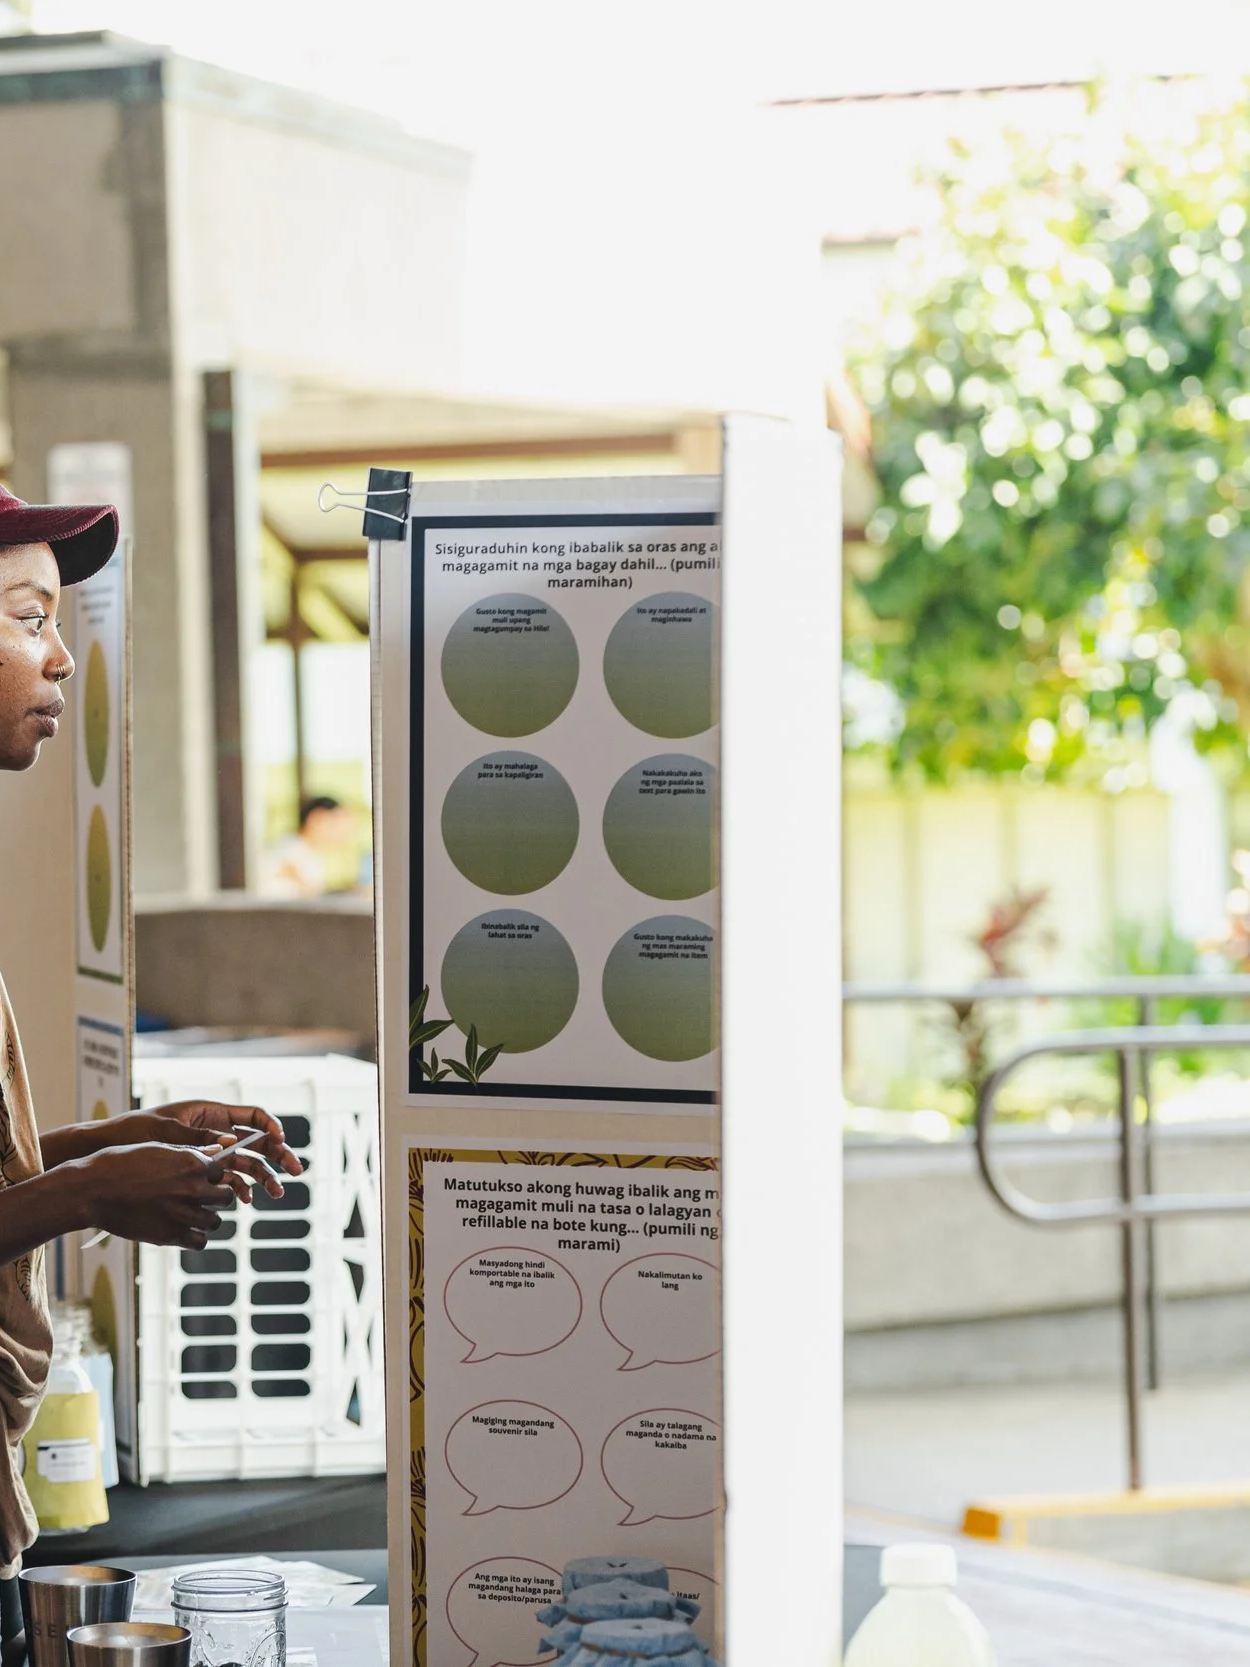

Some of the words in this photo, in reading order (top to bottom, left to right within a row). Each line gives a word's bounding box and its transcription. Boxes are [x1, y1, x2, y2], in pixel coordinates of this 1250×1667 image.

[436, 542, 528, 557] Sisiguraduhin
[532, 542, 565, 556] kong
[570, 541, 624, 553] ibabalik
[628, 543, 643, 552] sa
[647, 543, 676, 552] oras
[680, 543, 706, 555] ang
[442, 560, 518, 574] magagamit
[523, 562, 539, 571] na
[544, 562, 572, 573] mga
[576, 559, 617, 573] bagay
[621, 559, 666, 570] dahil...
[671, 558, 720, 573] (pumili
[548, 576, 633, 589] maramihan)
[498, 608, 515, 616] kong
[517, 608, 547, 616] magamit
[658, 607, 699, 615] napakadali
[651, 616, 692, 624] maginhawa
[504, 763, 538, 771] mahalaga
[478, 772, 494, 780] para
[505, 772, 543, 780] kapaligiran
[673, 788, 694, 796] gawin
[656, 934, 674, 942] kong
[642, 943, 651, 951] ng
[669, 943, 705, 951] maraming
[639, 951, 679, 959] magagamit
[444, 1178, 523, 1193] Matutukso
[526, 1181, 572, 1198] akong
[575, 1182, 624, 1200] huwag
[628, 1184, 670, 1198] ibalik
[674, 1188, 701, 1202] ang
[456, 1199, 537, 1213] magagamit
[541, 1200, 573, 1213] muli
[578, 1203, 596, 1213] na
[600, 1203, 631, 1215] tasa
[636, 1205, 645, 1215] o
[649, 1203, 711, 1220] lalagyan
[462, 1215, 527, 1229] refillable
[531, 1220, 548, 1230] na
[553, 1218, 586, 1232] bote
[591, 1219, 639, 1236] kung...
[643, 1222, 696, 1237] (pumili
[701, 1226, 719, 1240] ng
[558, 1239, 621, 1253] marami)
[479, 1260, 524, 1270] Masyadong
[525, 1261, 545, 1269] hindi
[470, 1269, 520, 1278] komportable
[533, 1271, 555, 1279] ibalik
[638, 1271, 690, 1280] Nakalimutan
[490, 1280, 504, 1288] ang
[506, 1281, 522, 1289] mga
[524, 1280, 535, 1288] ito
[662, 1281, 679, 1291] lang
[472, 1416, 507, 1426] Magiging
[509, 1419, 554, 1429] magandang
[640, 1420, 654, 1428] Sila
[668, 1422, 702, 1432] talagang
[489, 1427, 522, 1435] souvenir
[525, 1428, 538, 1436] sila
[626, 1430, 662, 1439] maganda
[672, 1433, 704, 1441] nadama
[655, 1441, 687, 1449] kakaiba
[475, 1573, 490, 1582] Ang
[492, 1575, 508, 1583] mga
[534, 1577, 555, 1586] isang
[469, 1582, 514, 1593] magandang
[515, 1585, 541, 1595] halaga
[543, 1588, 561, 1596] para
[488, 1593, 551, 1604] deposito/parusa
